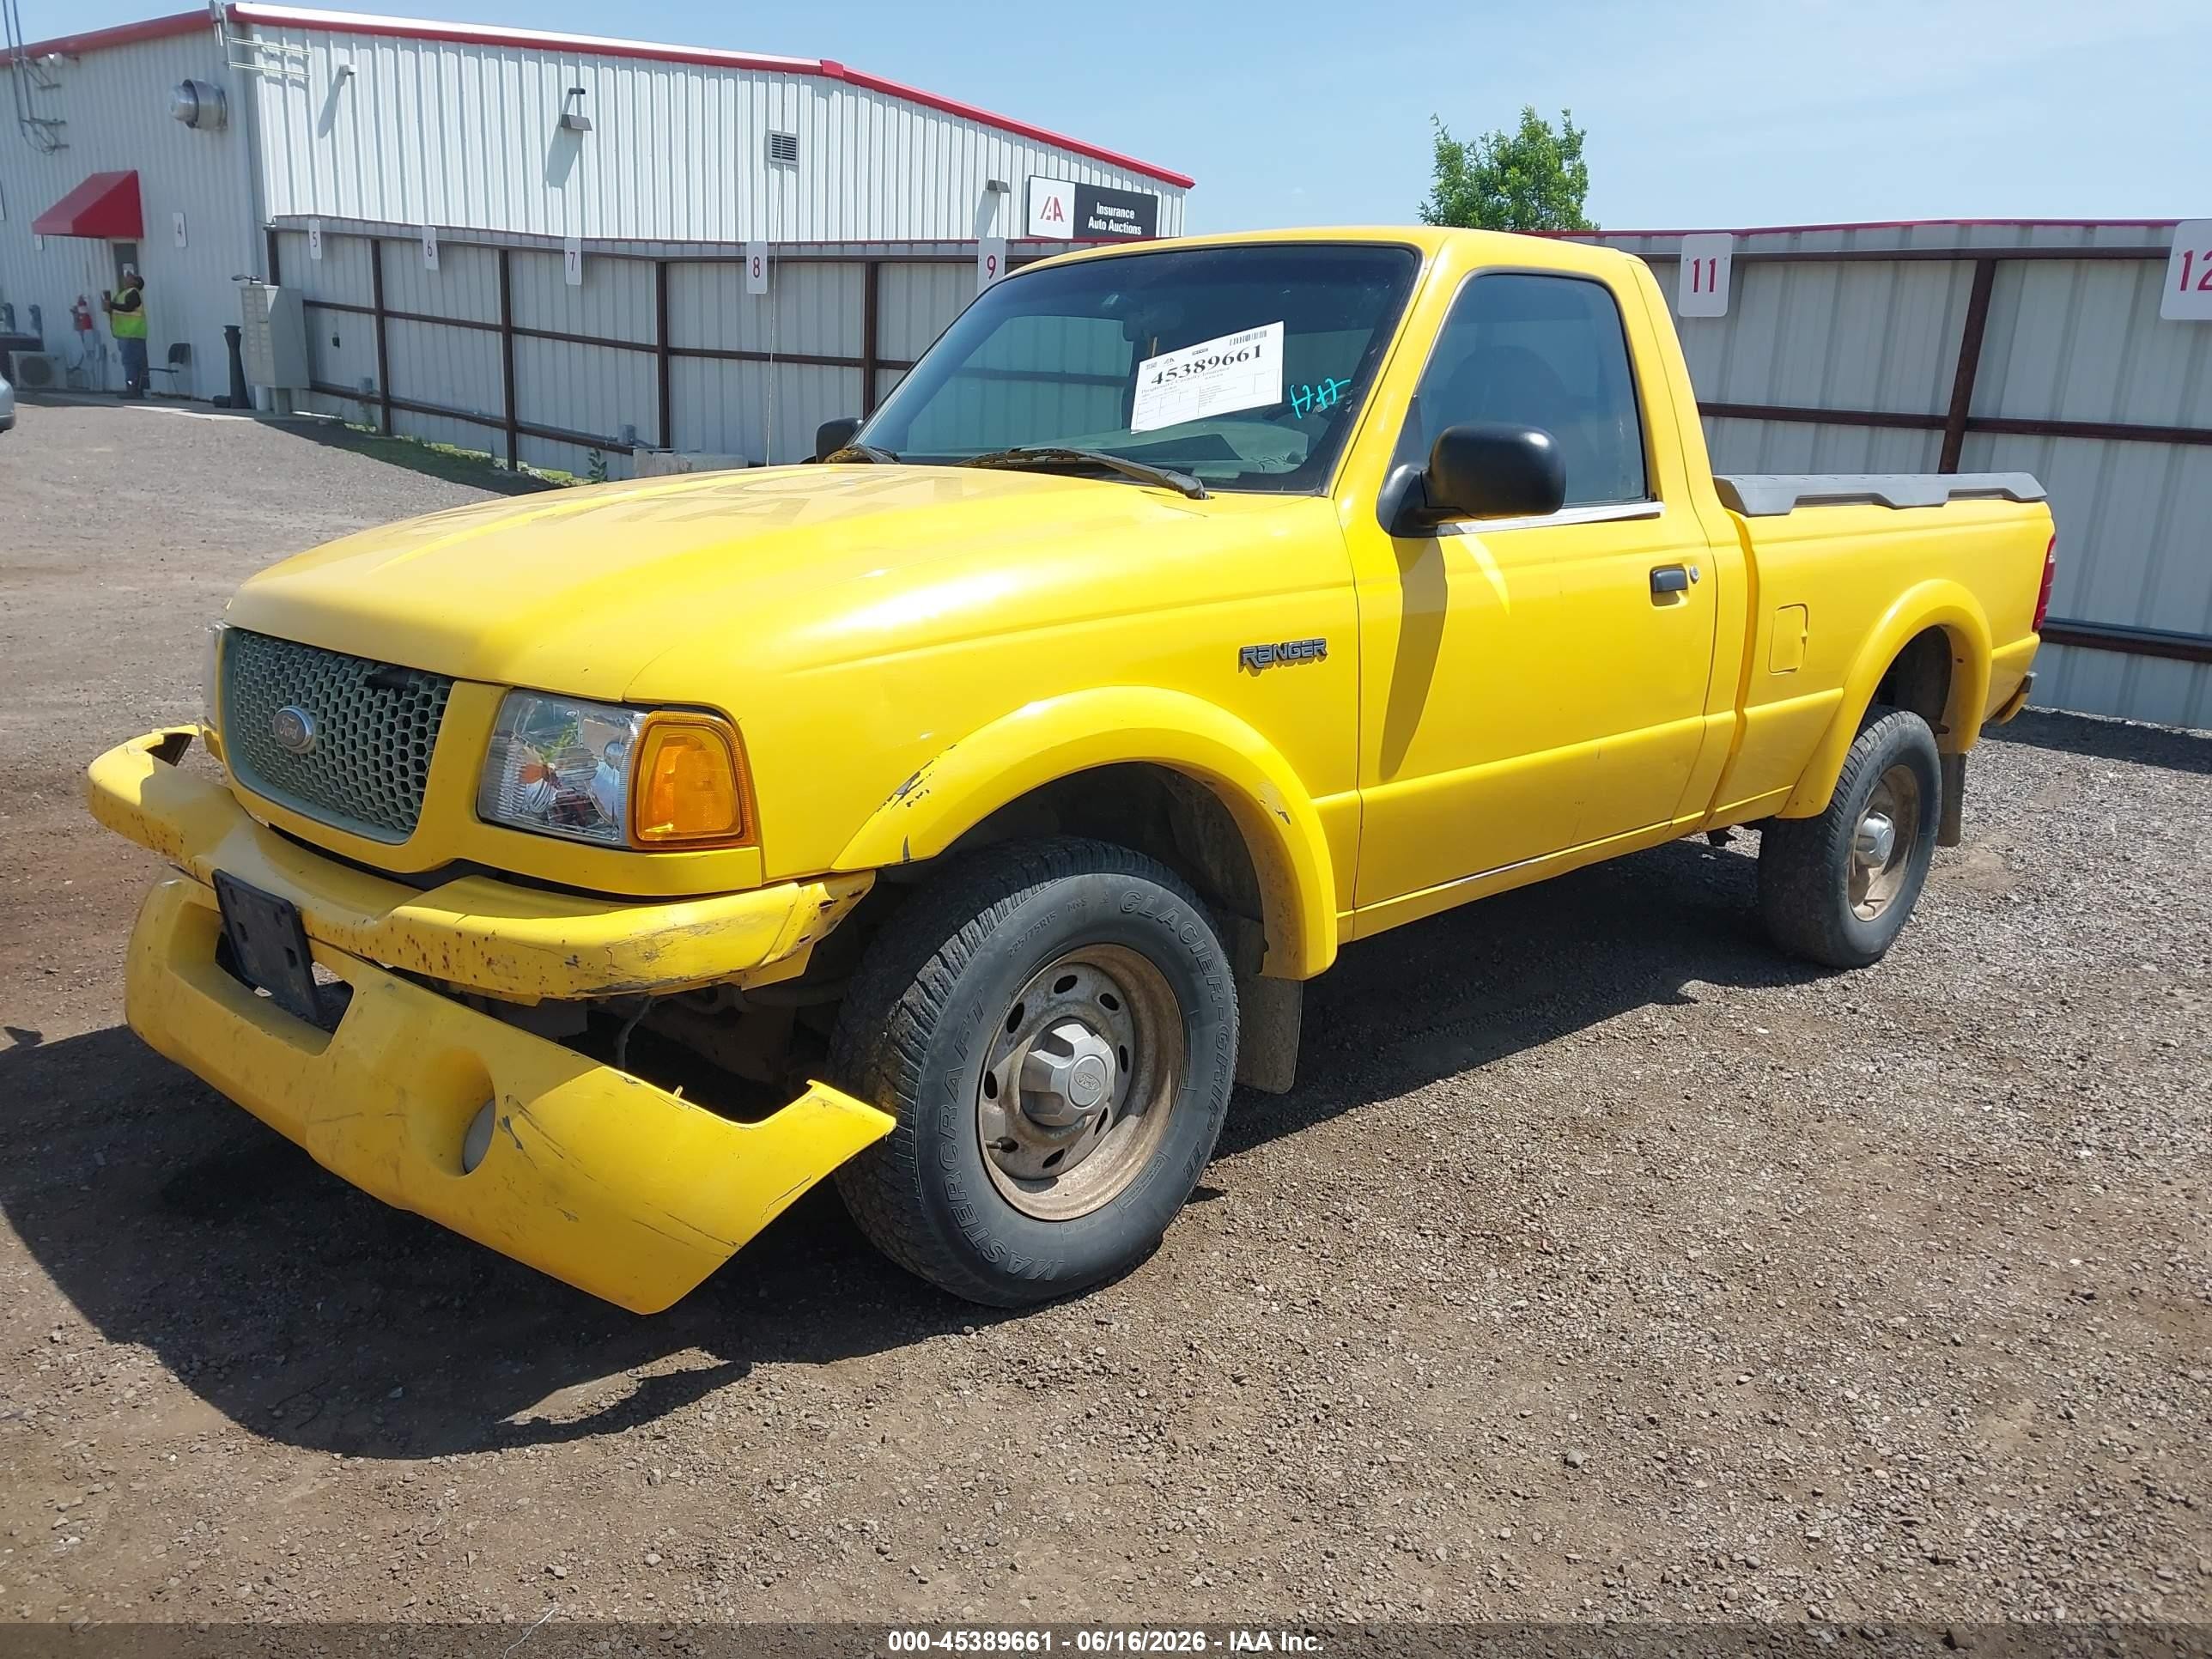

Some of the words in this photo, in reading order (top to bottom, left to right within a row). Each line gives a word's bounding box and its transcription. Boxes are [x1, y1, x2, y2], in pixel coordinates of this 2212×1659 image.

[1096, 201, 1135, 219] Insurance
[177, 222, 183, 237] 4
[1087, 216, 1107, 231] Auto
[1108, 219, 1142, 235] Auctions
[312, 231, 318, 248] 5
[427, 240, 433, 258] 6
[569, 251, 576, 272] 7
[752, 256, 761, 279] 8
[987, 254, 997, 280] 9
[2179, 249, 2212, 292] 12
[1692, 258, 1717, 293] 11
[1151, 343, 1262, 385] 45389661
[1242, 638, 1328, 668] RANGER
[278, 714, 300, 740] Ford
[938, 988, 1066, 1281] MASTERCRAFT
